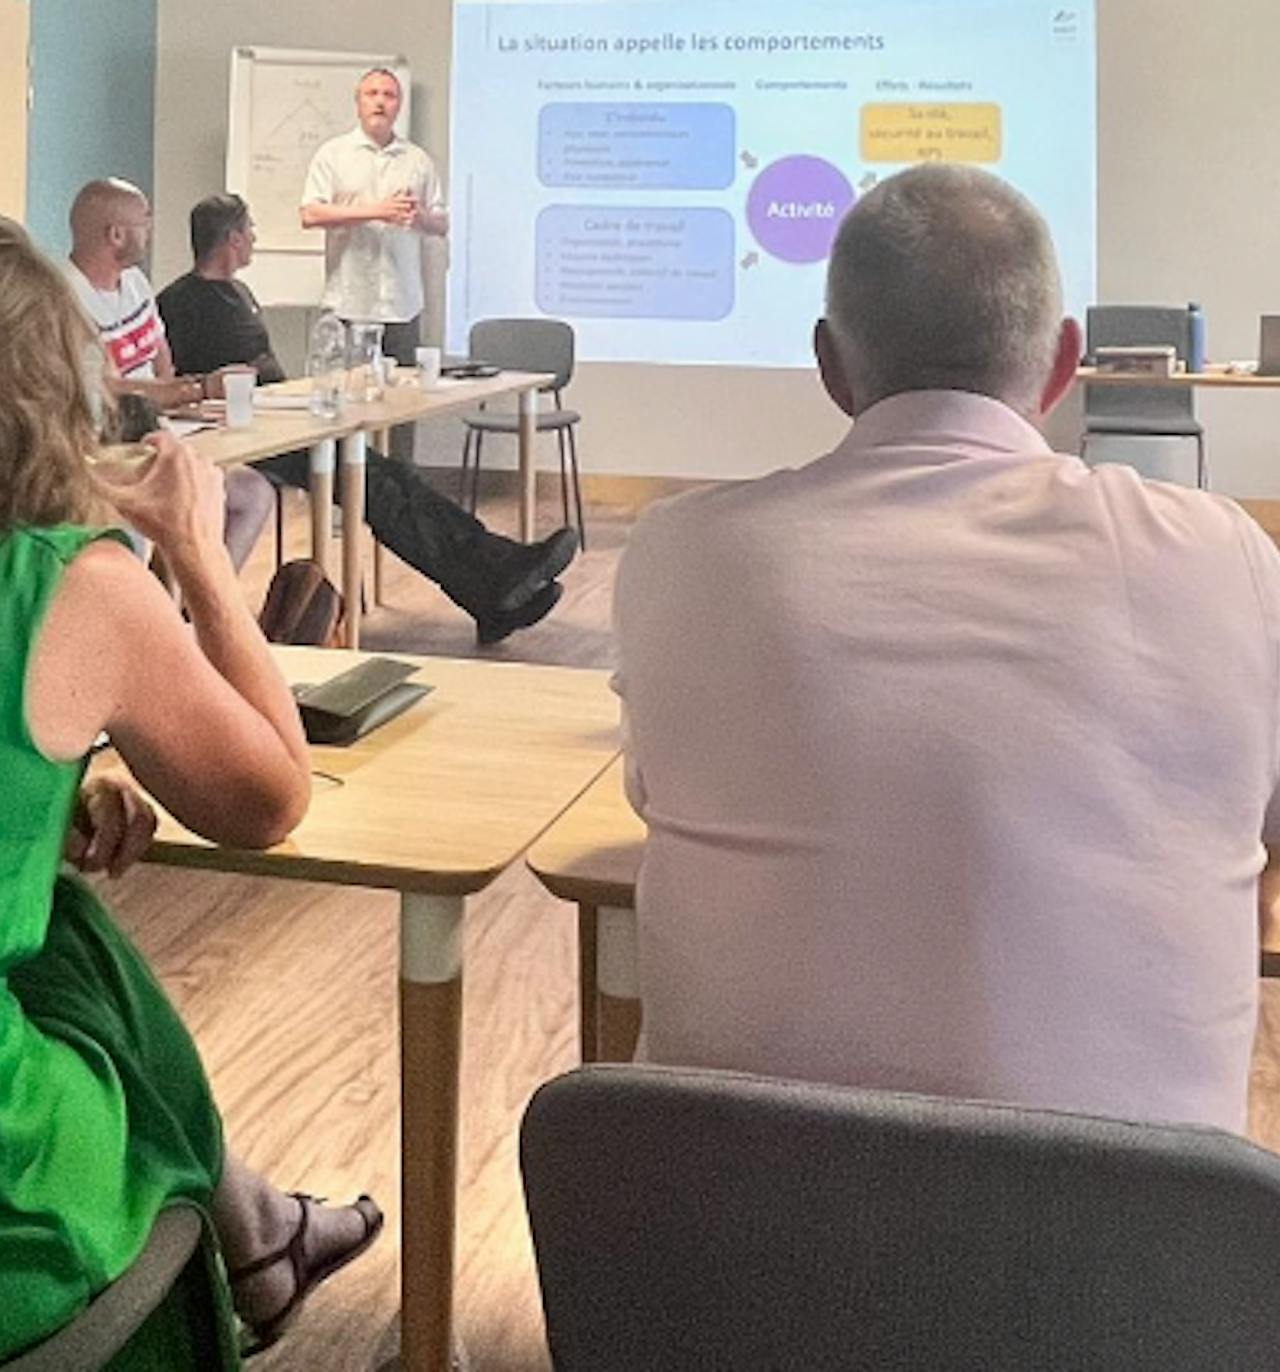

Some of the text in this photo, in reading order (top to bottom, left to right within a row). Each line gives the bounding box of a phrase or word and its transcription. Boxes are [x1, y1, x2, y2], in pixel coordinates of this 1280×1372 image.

[498, 32, 885, 54] La situation appelle les comportements
[766, 200, 834, 218] Activité
